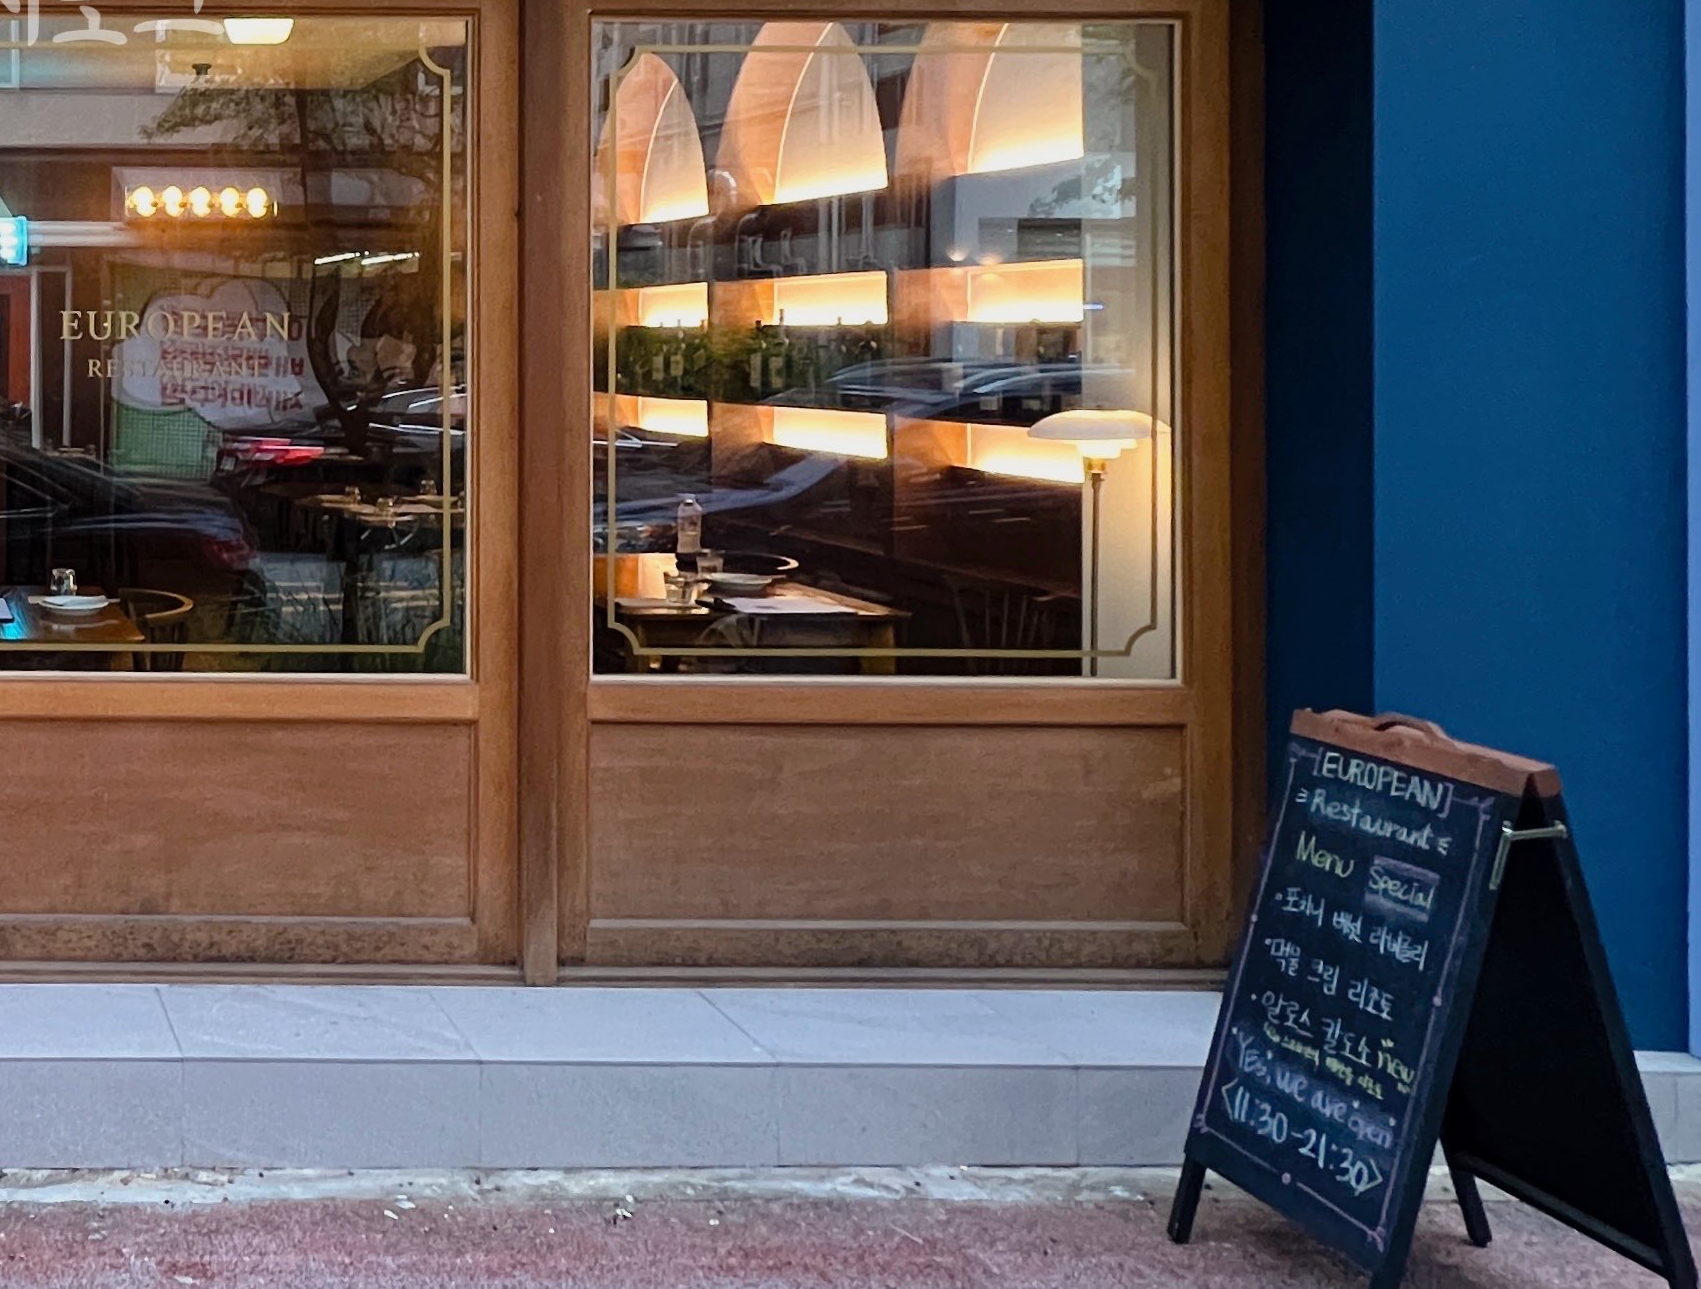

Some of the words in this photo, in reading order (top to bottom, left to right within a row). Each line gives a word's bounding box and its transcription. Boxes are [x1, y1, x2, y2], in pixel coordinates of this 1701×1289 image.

[59, 310, 291, 342] EUROPEAN
[87, 358, 264, 380] RESTAURANT
[1310, 788, 1433, 850] Restaurant
[1296, 830, 1354, 878] Menu
[1368, 865, 1436, 909] Special
[1310, 1090, 1348, 1123] are
